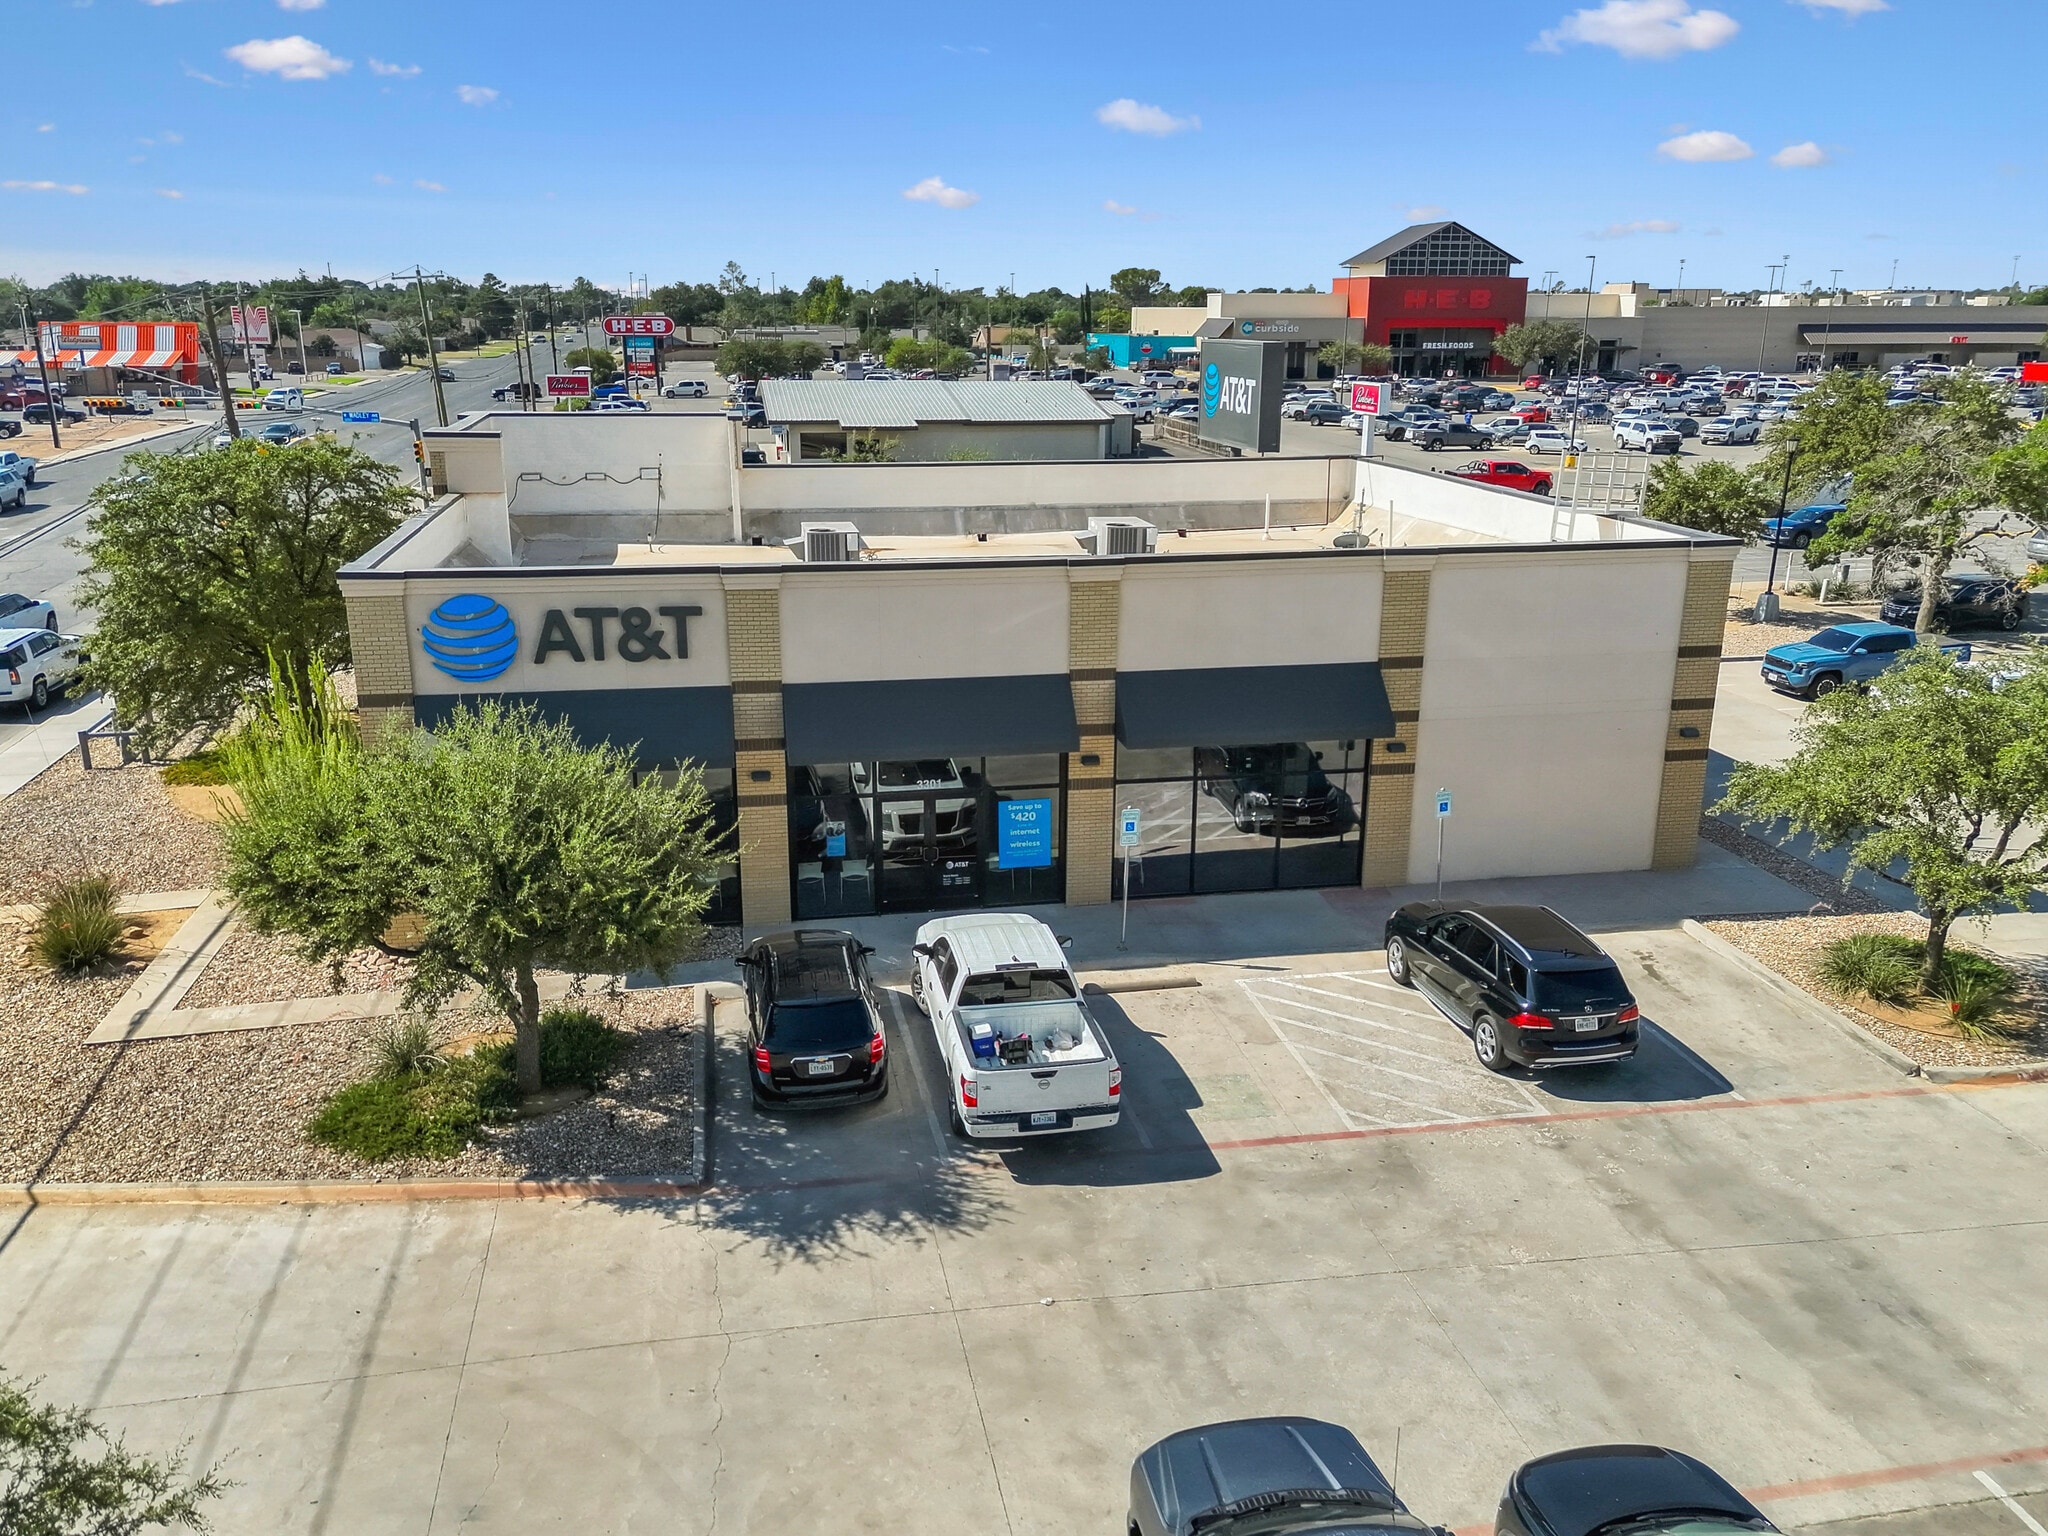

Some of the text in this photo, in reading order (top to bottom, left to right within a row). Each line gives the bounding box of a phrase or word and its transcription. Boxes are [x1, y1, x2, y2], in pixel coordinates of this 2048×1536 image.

[1255, 324, 1299, 333] curbside
[1422, 342, 1447, 350] FRESH
[1220, 376, 1256, 415] AT&T
[534, 606, 703, 664] AT&T
[916, 779, 942, 789] 3301
[1011, 811, 1036, 822] $420
[1010, 828, 1040, 836] internet
[1010, 840, 1040, 848] wireless
